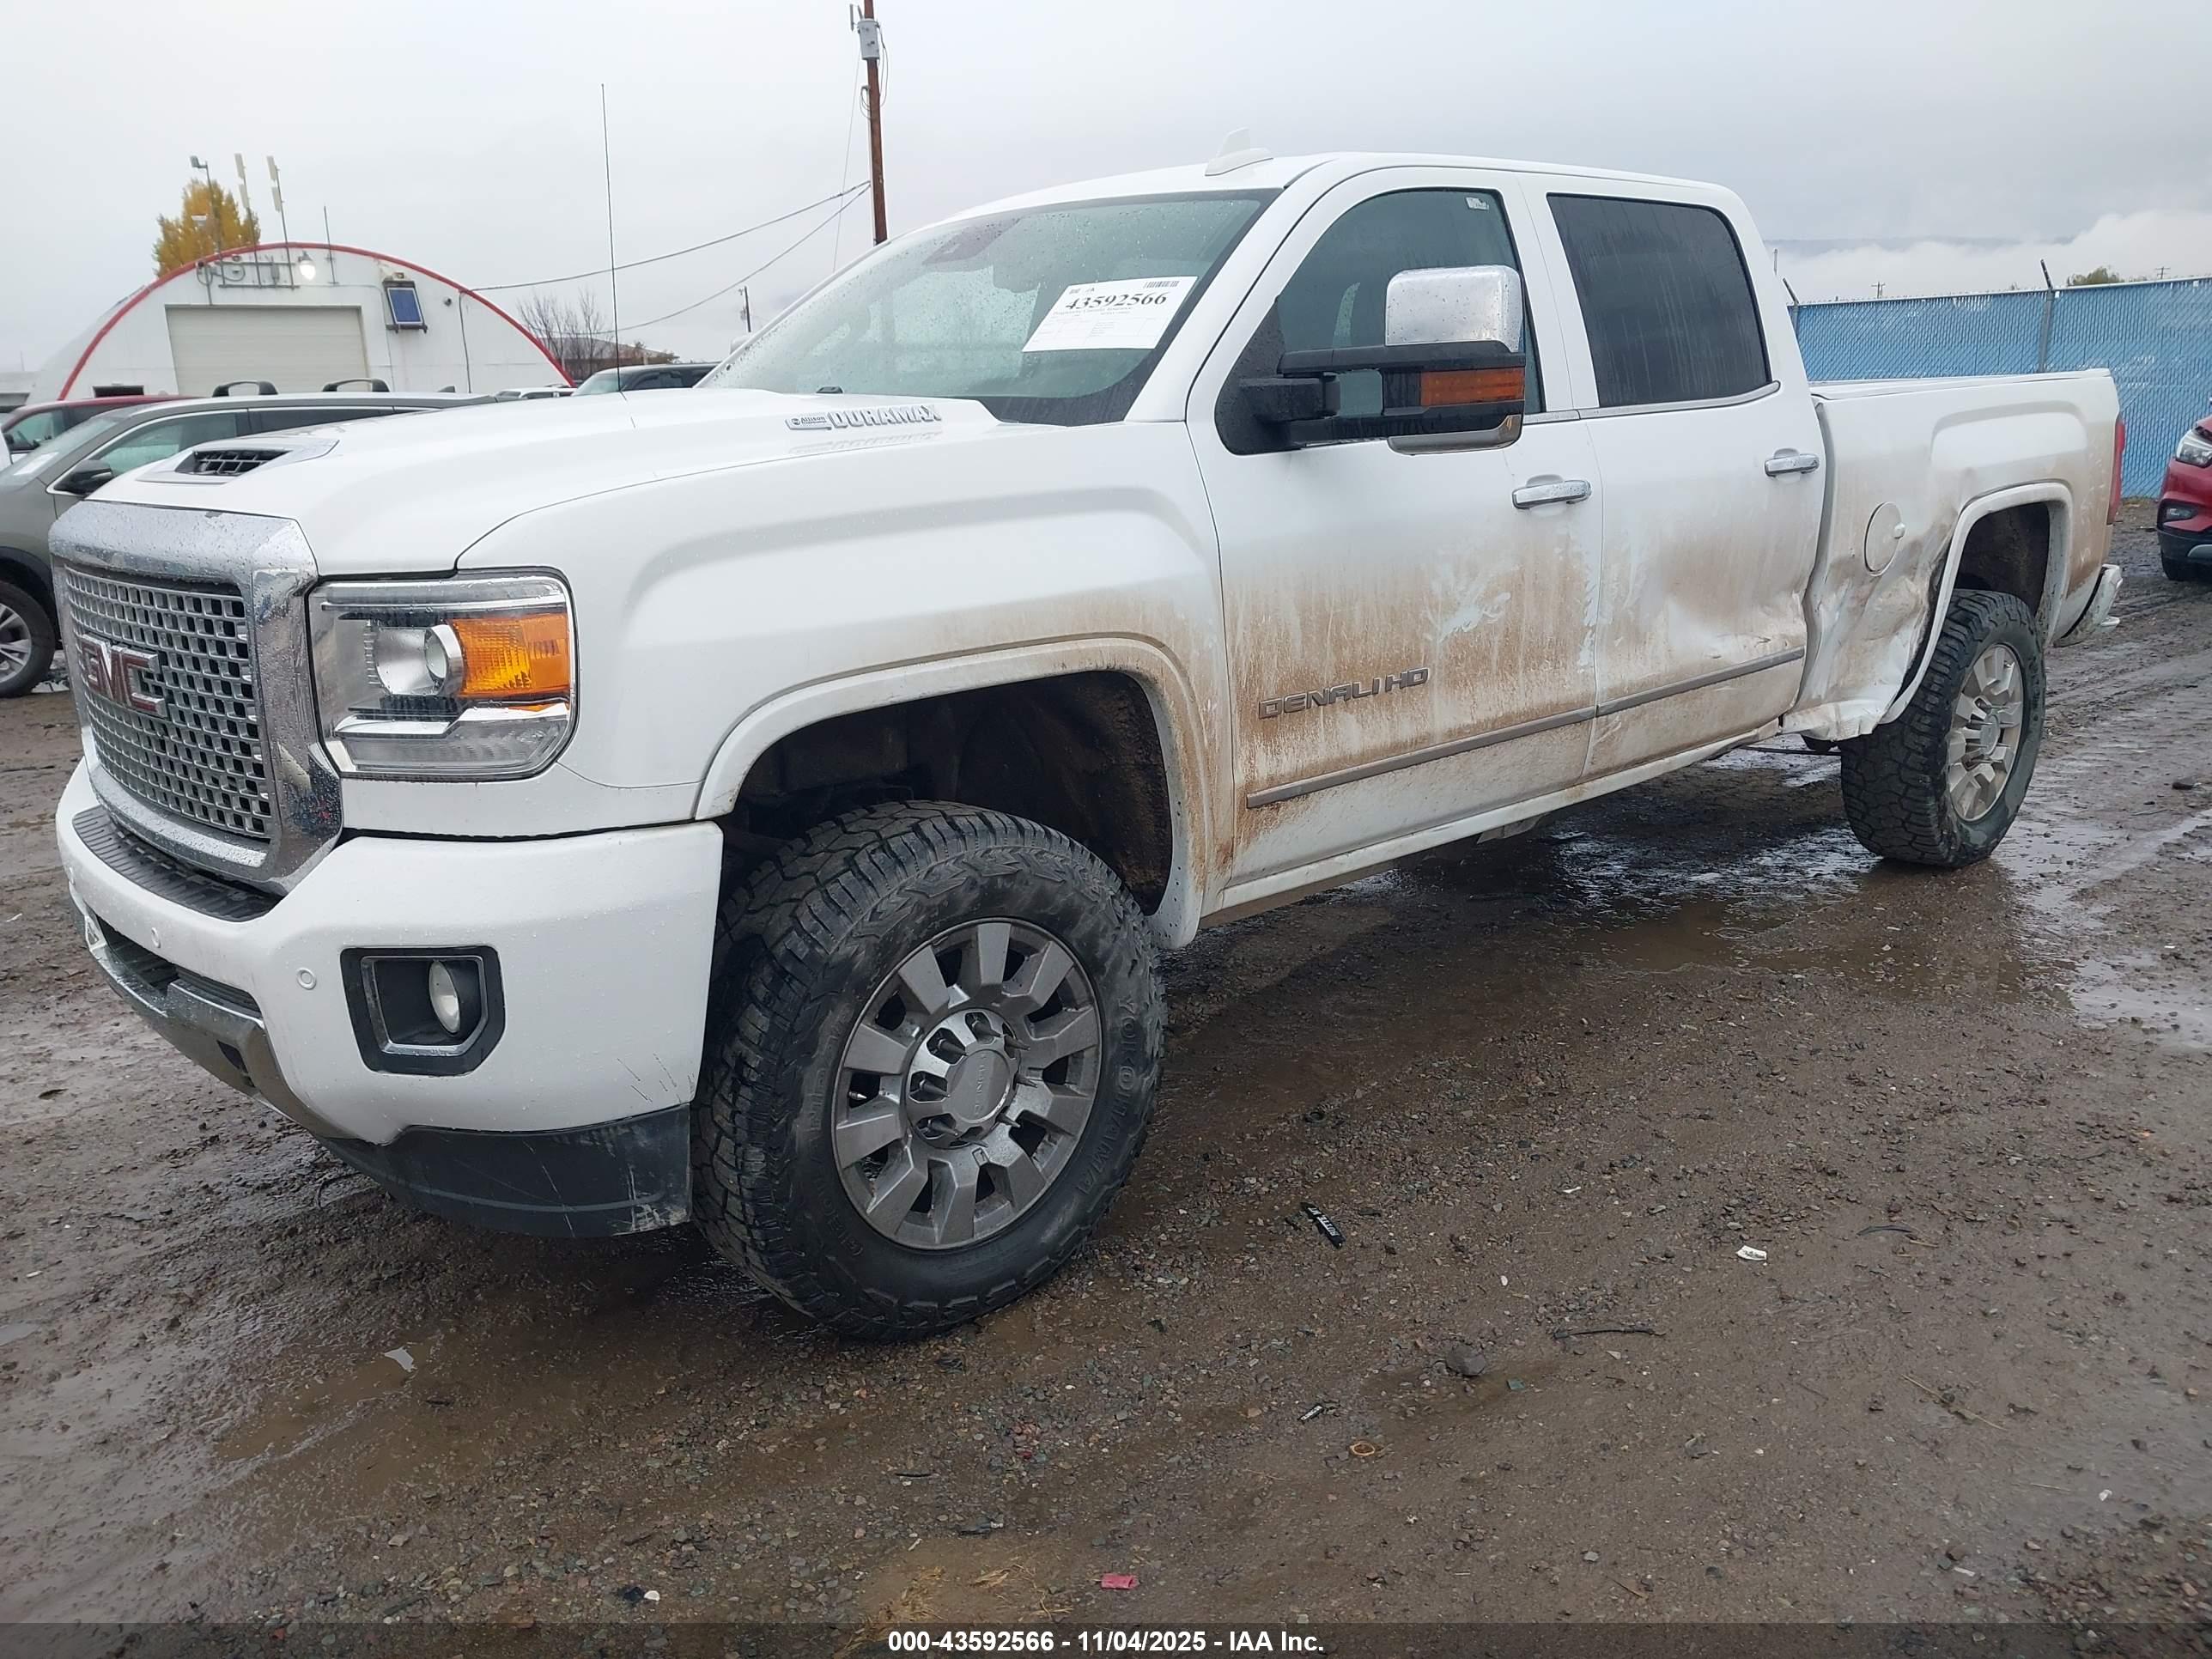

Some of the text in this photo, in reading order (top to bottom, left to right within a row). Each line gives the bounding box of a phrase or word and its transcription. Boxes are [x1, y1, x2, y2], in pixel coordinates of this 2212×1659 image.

[1065, 292, 1169, 310] 43592566
[828, 404, 941, 428] DURAMAX
[82, 634, 167, 718] GMC
[1258, 667, 1430, 720] DENALI HD
